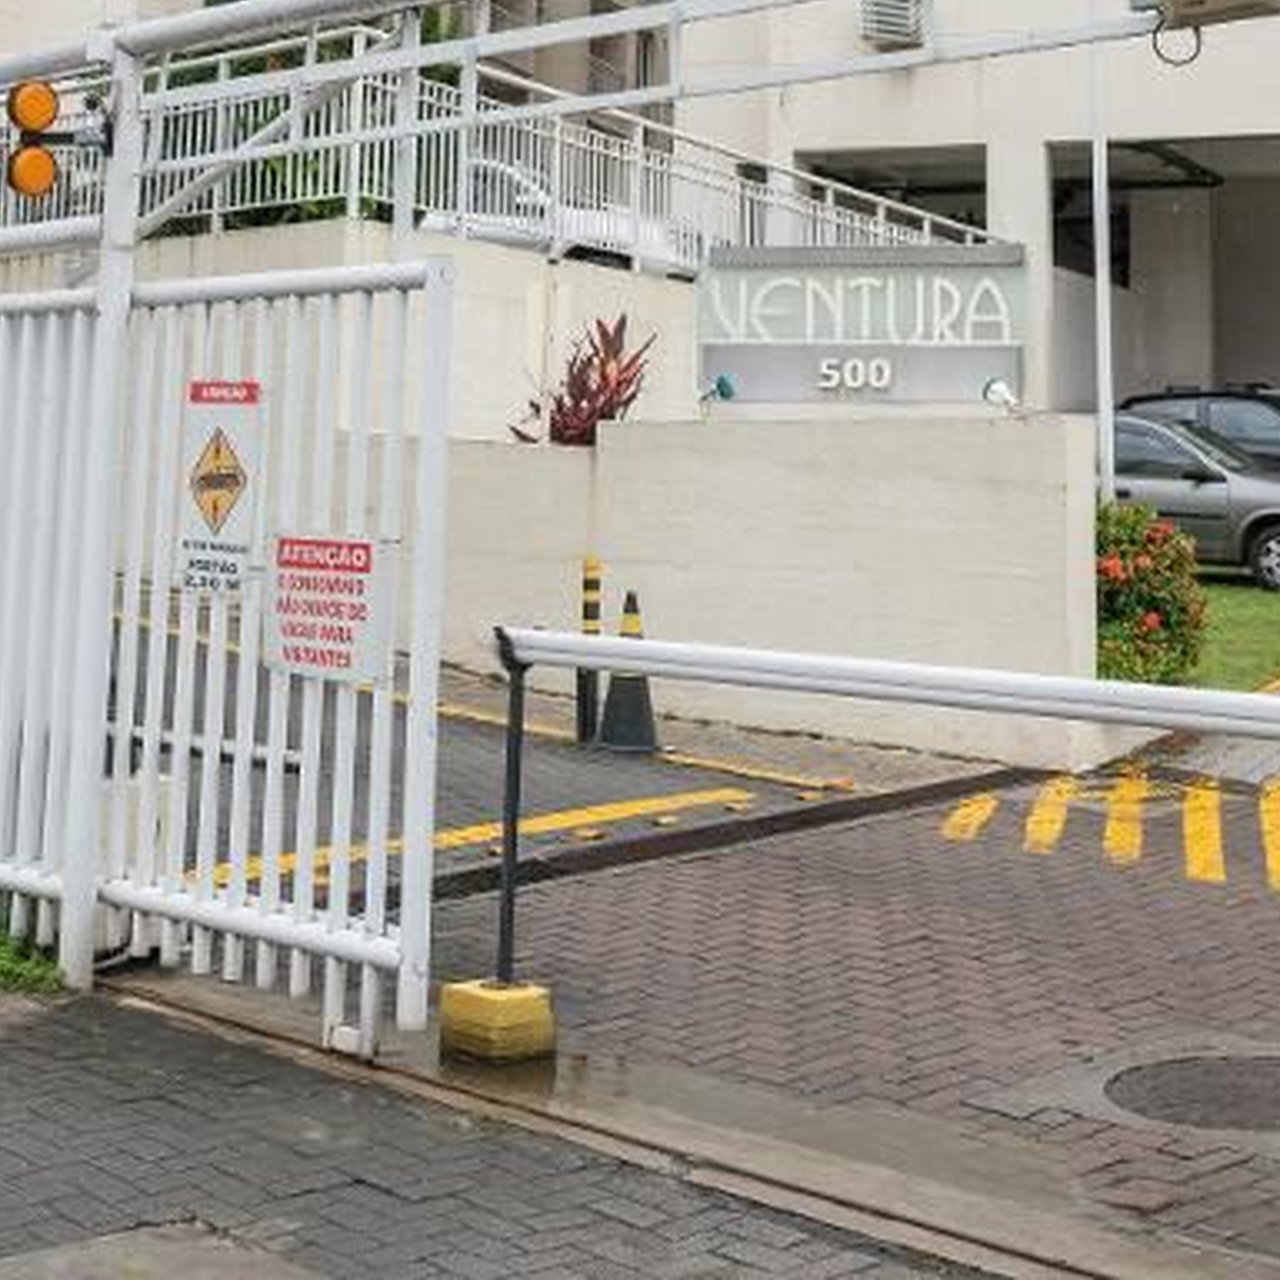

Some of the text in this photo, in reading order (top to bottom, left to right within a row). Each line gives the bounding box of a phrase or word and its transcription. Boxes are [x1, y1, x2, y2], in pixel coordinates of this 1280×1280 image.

[711, 276, 1011, 343] VENTURA
[818, 358, 892, 389] 500
[281, 542, 367, 570] ATENÇÃO
